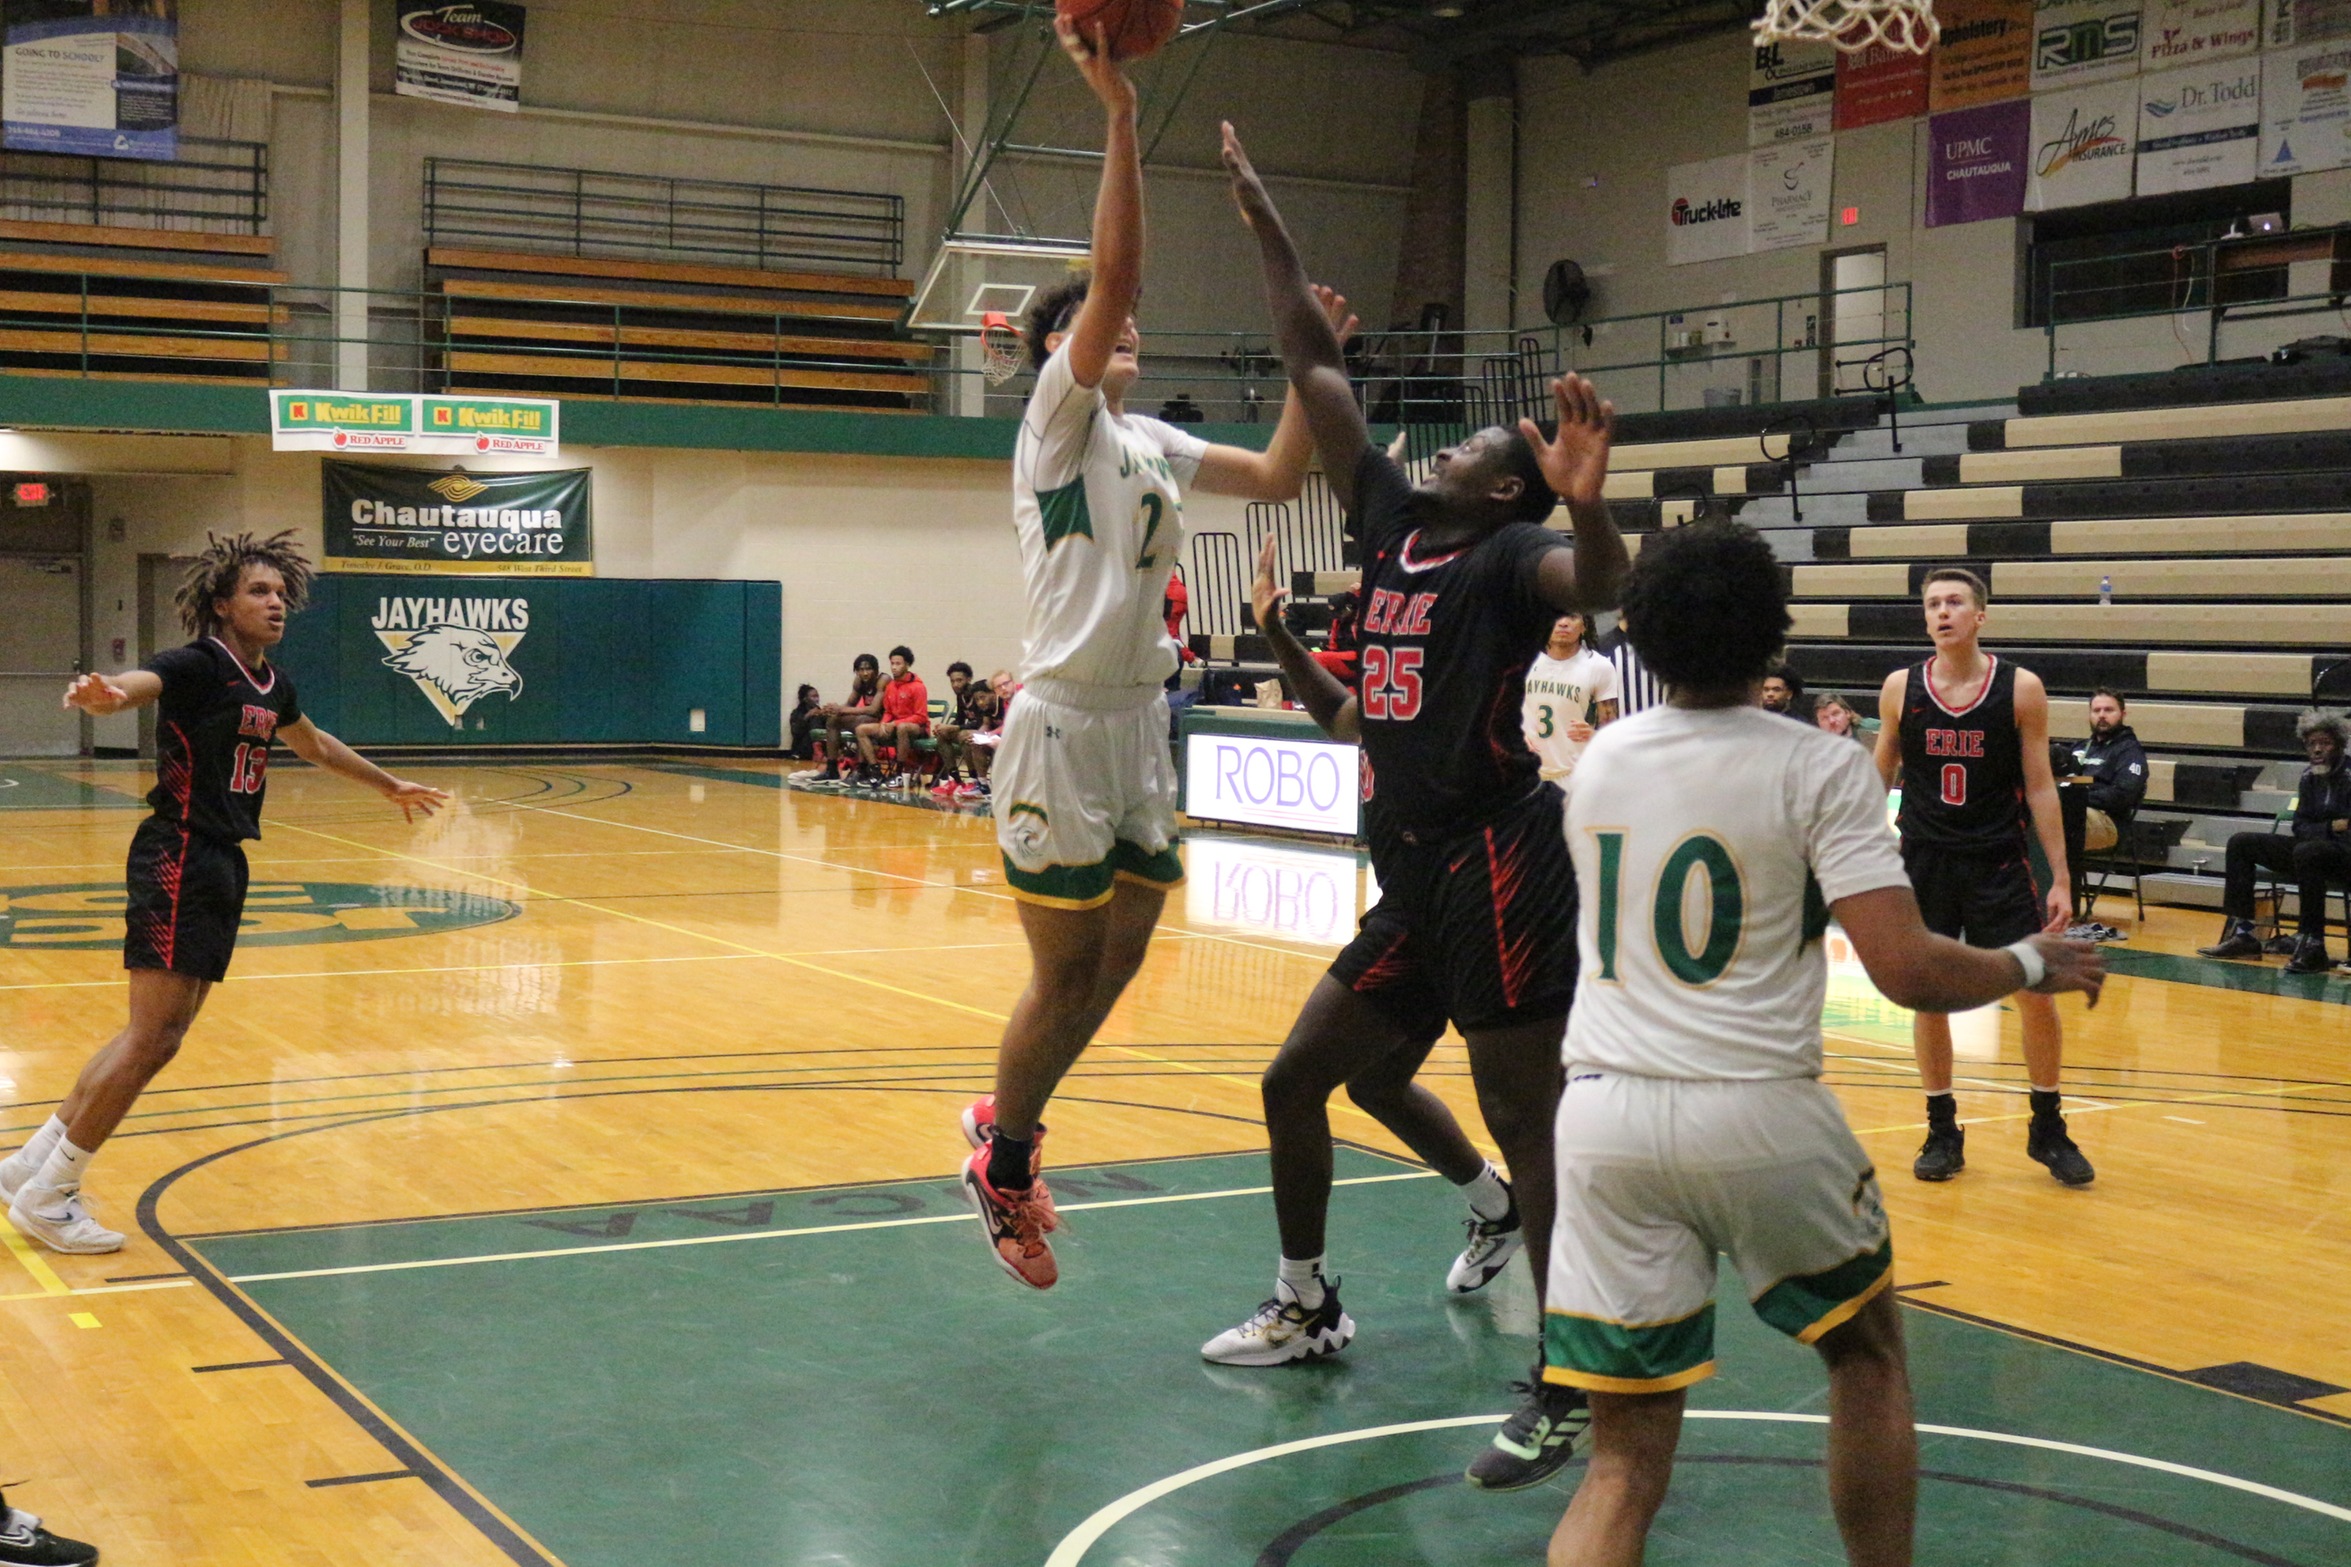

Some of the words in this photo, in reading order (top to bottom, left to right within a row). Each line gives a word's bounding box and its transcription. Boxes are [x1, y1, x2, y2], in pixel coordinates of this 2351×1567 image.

[435, 4, 482, 23] Team
[15, 46, 47, 60] GOING
[48, 49, 61, 60] TO
[2036, 10, 2140, 70] RMS
[2151, 40, 2188, 59] Pizza
[2191, 36, 2205, 51] &
[2210, 30, 2255, 50] Wings
[2182, 86, 2207, 109] Dr.
[2210, 74, 2257, 104] Todd
[1945, 136, 1993, 160] UPMC
[2072, 142, 2128, 163] INSURANCE
[1946, 161, 2012, 181] CHAUTAUQUA
[1675, 197, 1743, 226] Truck-Lite
[349, 435, 371, 446] RED
[372, 435, 405, 447] APPLE
[492, 439, 513, 450] RED
[513, 439, 544, 451] APPLE
[351, 498, 563, 534] Chautauqua
[378, 535, 405, 549] Your
[443, 530, 564, 560] eyecare
[513, 564, 533, 573] West
[533, 564, 557, 573] Third
[558, 564, 583, 574] Street
[370, 597, 530, 631] JAYHAWKS
[1363, 587, 1439, 636] ERIE
[1363, 645, 1425, 722] 25
[1526, 679, 1581, 704] AYHAWKS
[1538, 704, 1554, 740] 3
[1925, 728, 1985, 758] ERIE
[230, 742, 268, 795] 13
[1215, 743, 1342, 812] ROBO
[1940, 763, 1967, 807] 0
[1584, 825, 1748, 991] 10
[521, 1172, 1167, 1240] NCAA
